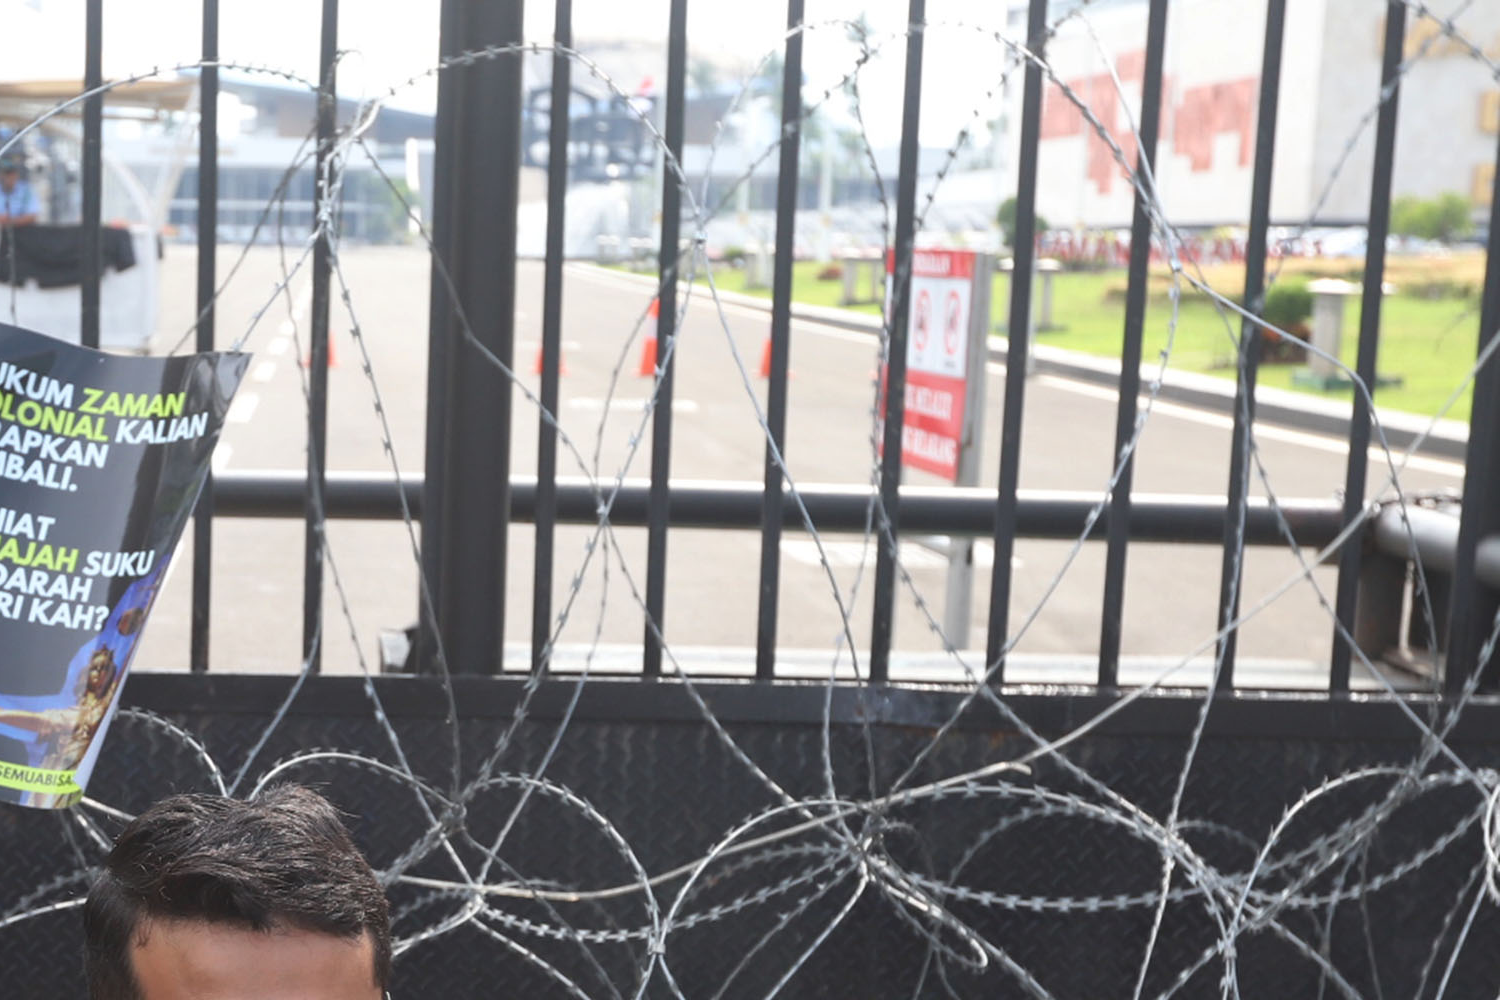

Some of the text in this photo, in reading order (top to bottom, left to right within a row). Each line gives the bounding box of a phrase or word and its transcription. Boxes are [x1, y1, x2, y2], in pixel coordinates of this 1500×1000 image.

[79, 388, 186, 417] ZAMAN
[114, 413, 209, 445] KALIAN
[82, 550, 155, 576] SUKU
[28, 598, 110, 631] KAH?
